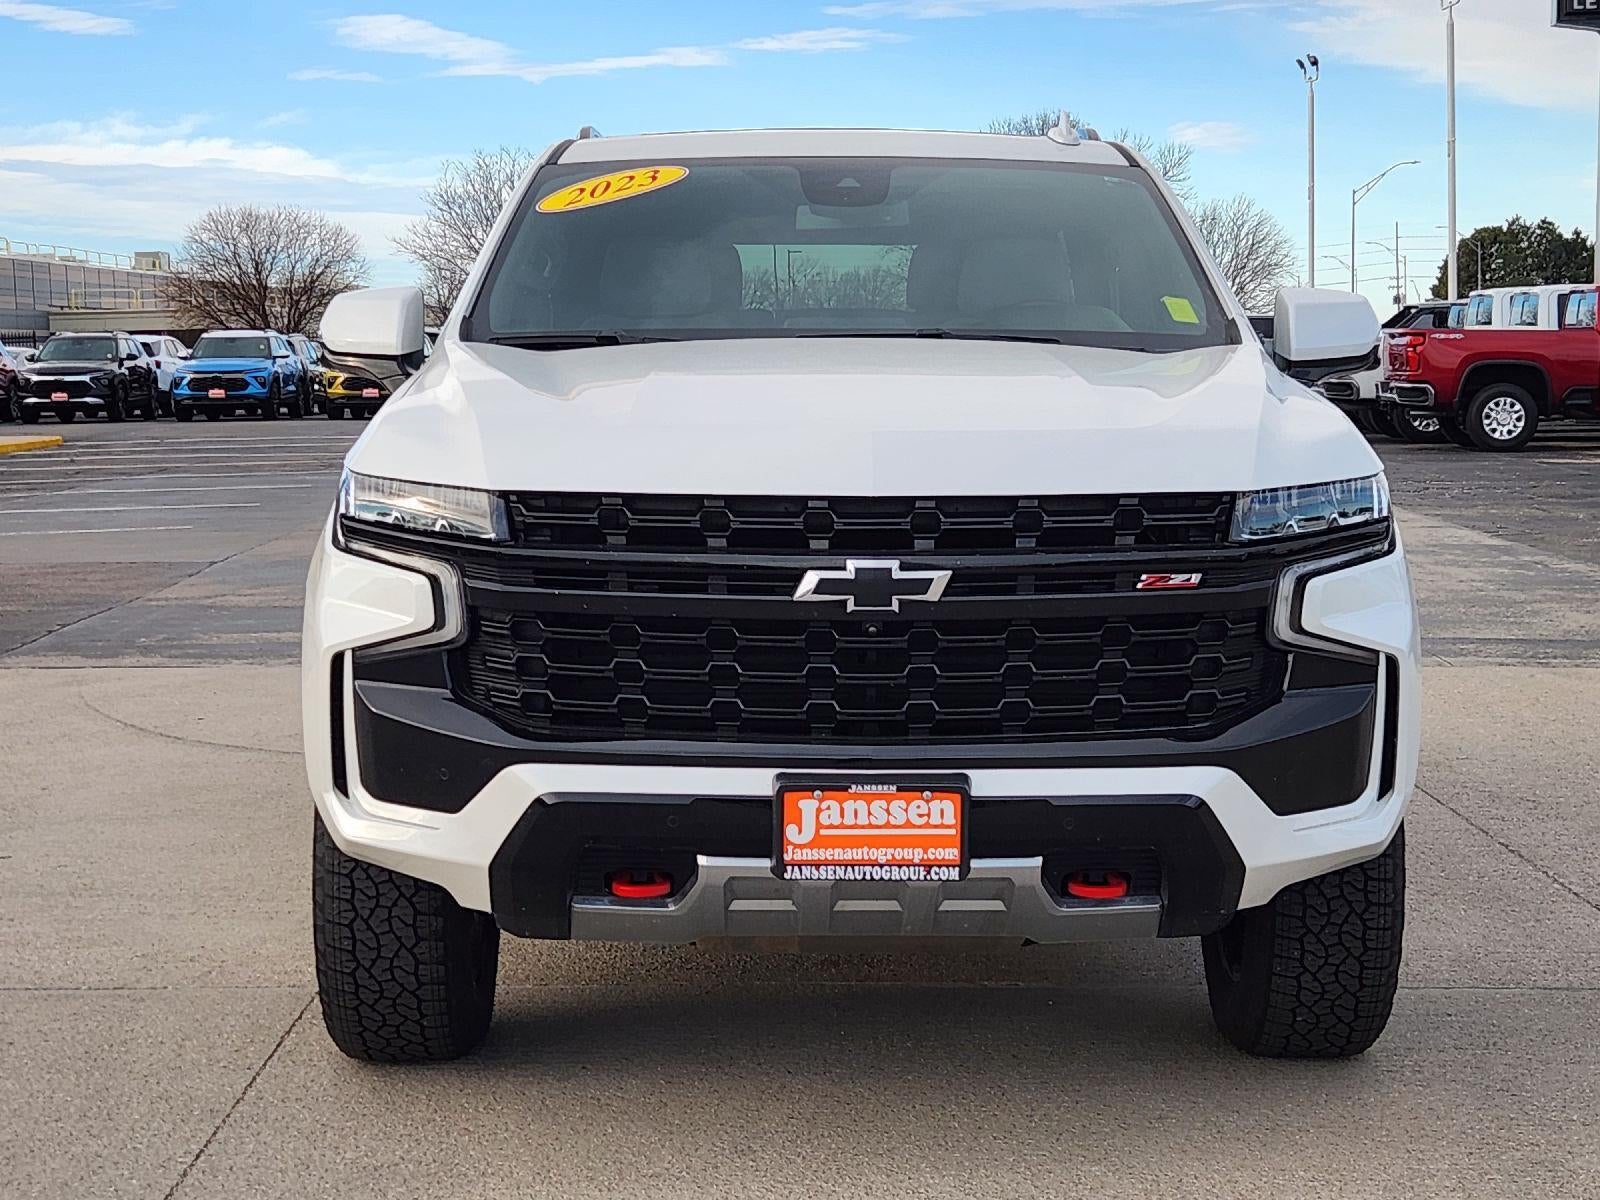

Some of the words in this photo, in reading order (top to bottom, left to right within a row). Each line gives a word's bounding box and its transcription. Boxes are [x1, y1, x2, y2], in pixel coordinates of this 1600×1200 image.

[564, 169, 661, 208] 2023
[1136, 573, 1203, 589] Z71
[847, 784, 897, 794] JANSSEN
[785, 799, 957, 845] Janssen
[783, 845, 959, 864] Janssenautogroup.com
